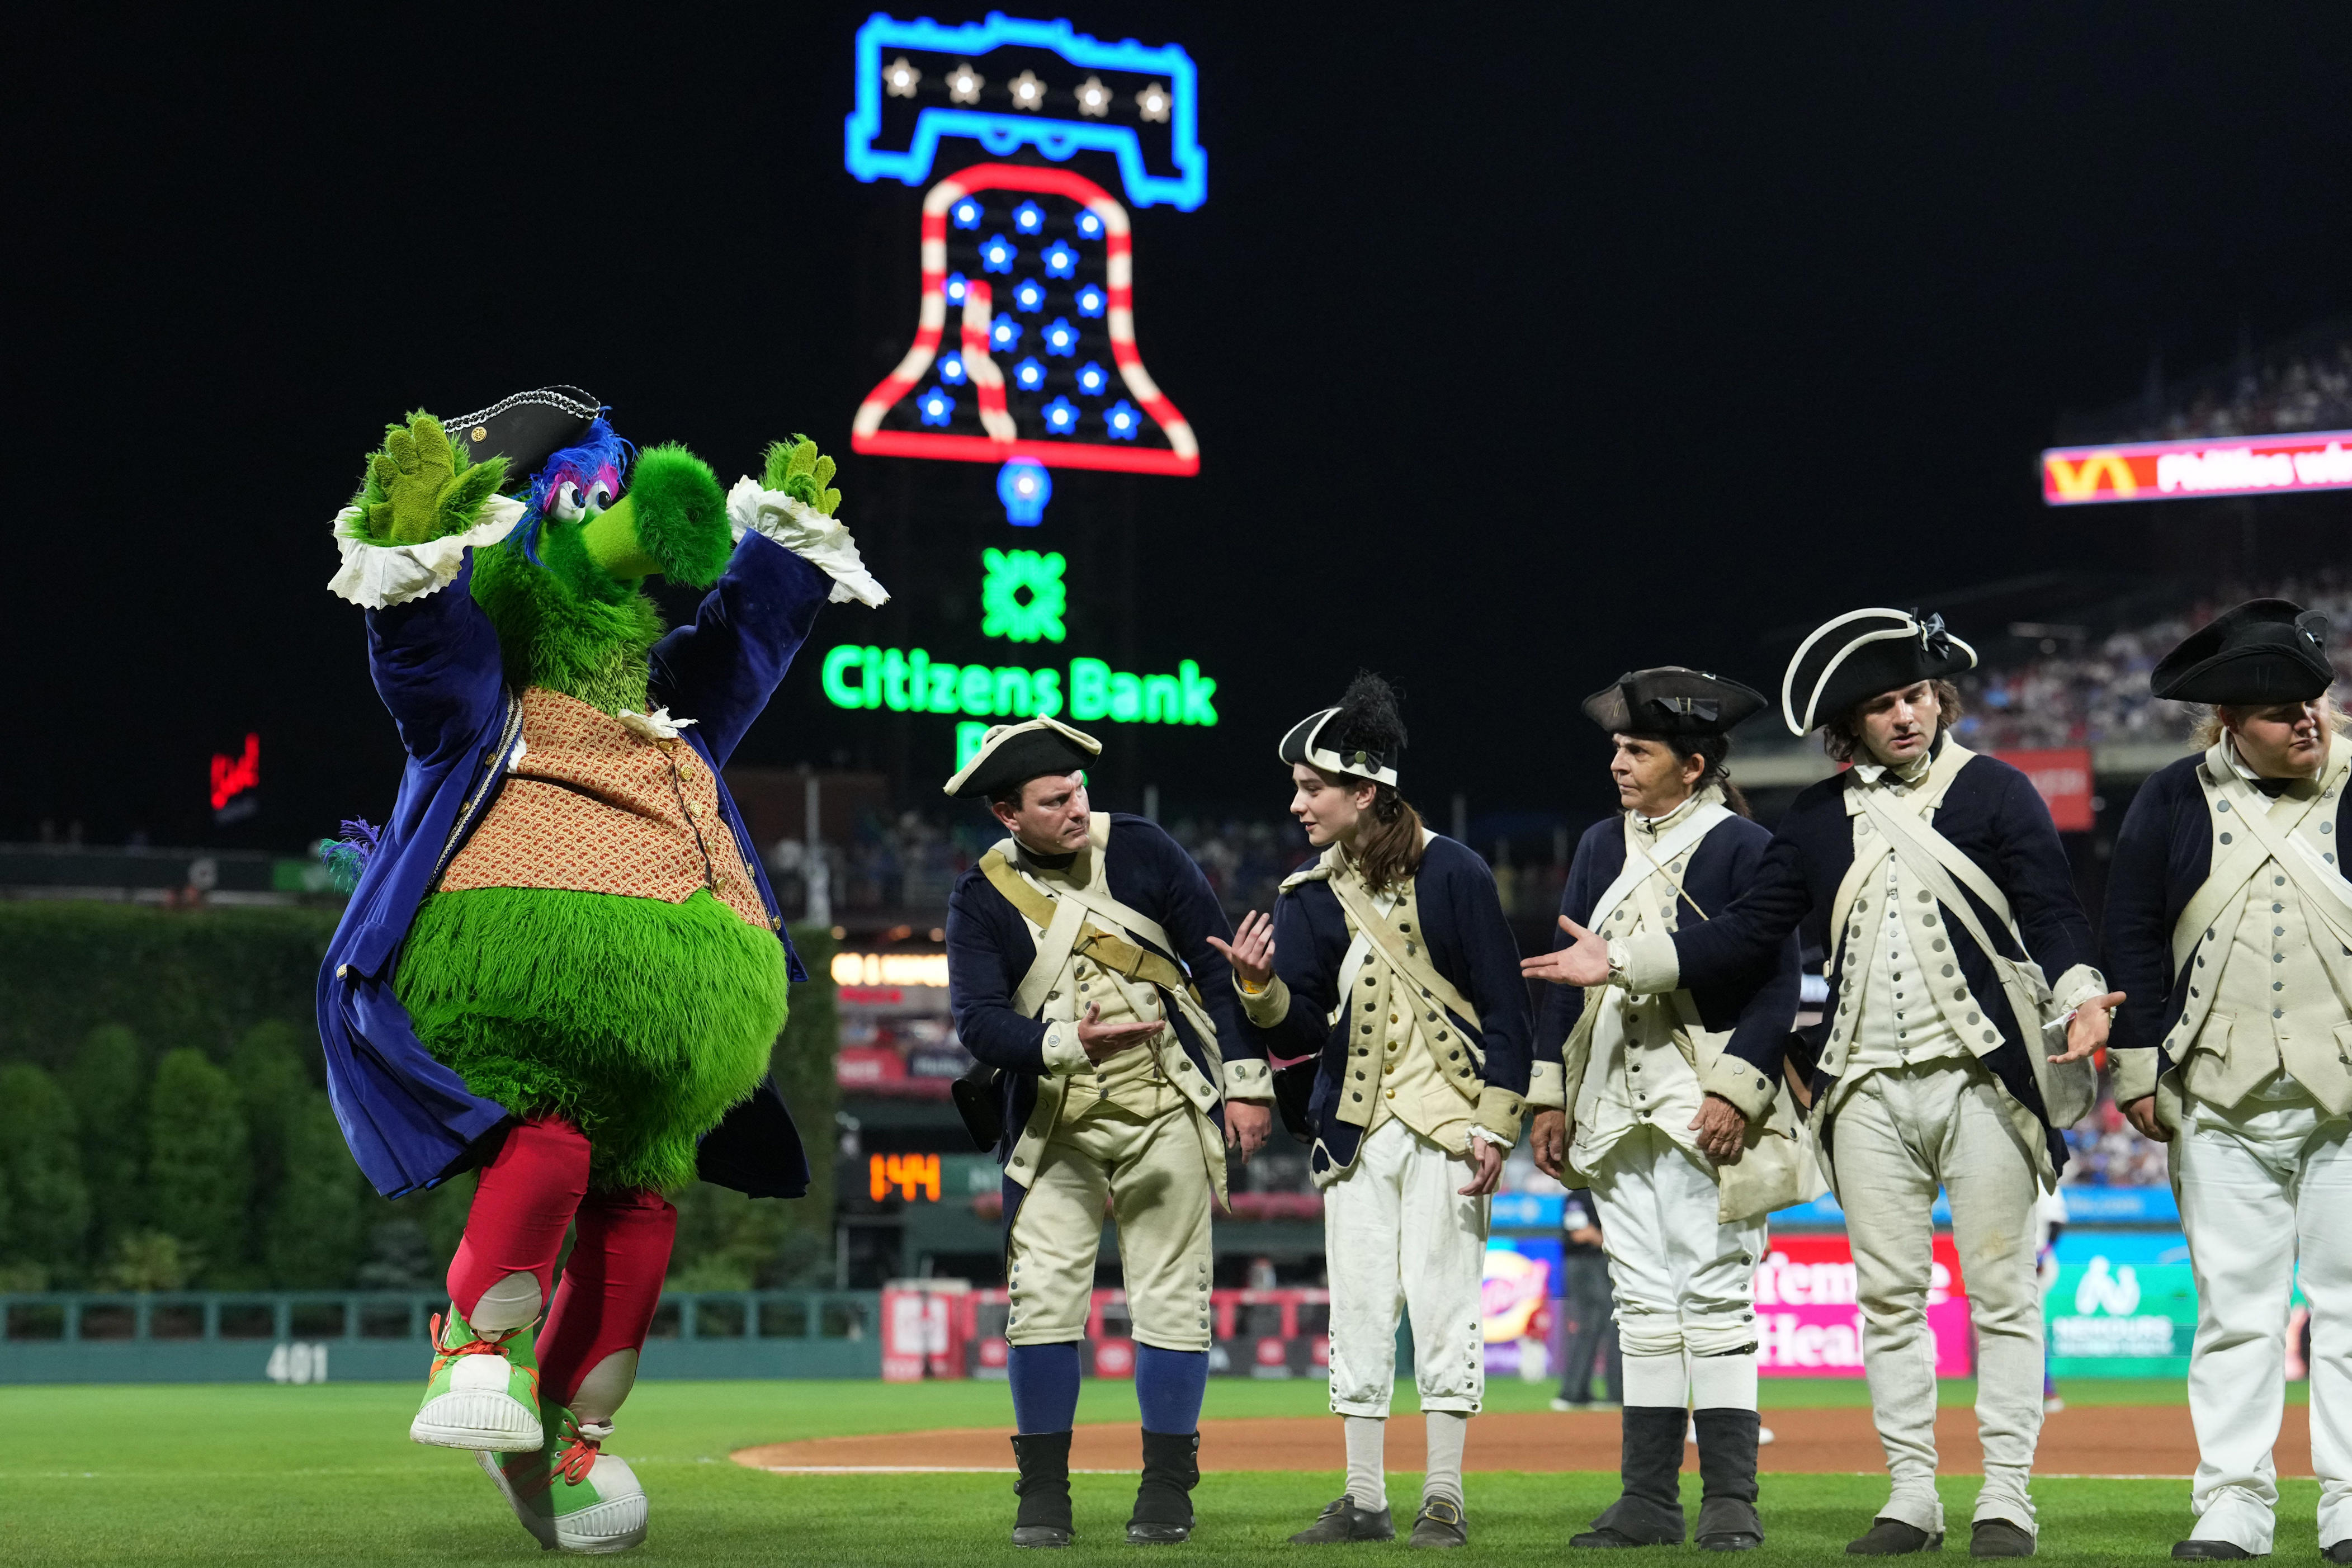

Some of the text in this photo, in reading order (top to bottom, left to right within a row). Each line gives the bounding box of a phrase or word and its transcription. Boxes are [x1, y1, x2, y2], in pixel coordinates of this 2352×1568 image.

[822, 645, 1218, 726] Citizens Bank
[266, 1342, 328, 1384] 401
